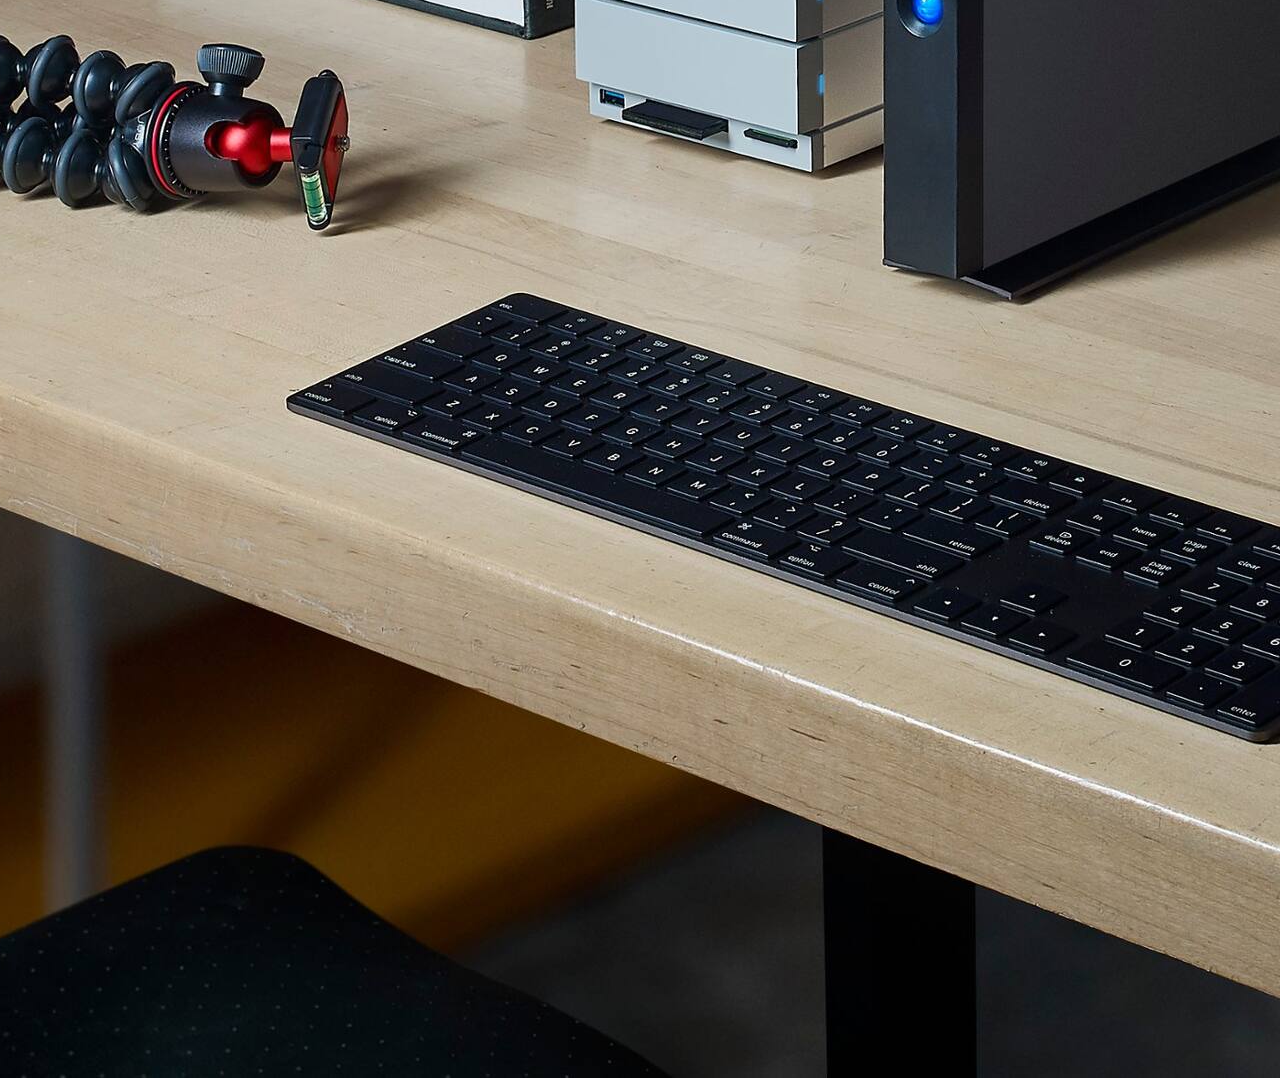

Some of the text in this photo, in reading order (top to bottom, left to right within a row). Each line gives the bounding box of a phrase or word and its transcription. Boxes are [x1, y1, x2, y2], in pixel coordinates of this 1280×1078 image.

[545, 345, 558, 353] 2
[384, 355, 401, 365] caps
[495, 354, 508, 362] Q
[533, 366, 549, 374] W
[573, 379, 587, 387] E
[505, 388, 518, 396] S
[613, 392, 626, 400] R
[304, 392, 332, 402] control
[446, 399, 460, 408] Z
[544, 400, 558, 408] D
[374, 415, 398, 426] option
[485, 413, 500, 421] X
[697, 418, 709, 426] Y
[526, 426, 539, 434] C
[626, 427, 639, 435] G
[421, 431, 459, 446] command
[568, 439, 581, 447] V
[666, 440, 682, 449] H
[607, 453, 621, 461] B
[648, 466, 664, 475] N
[751, 468, 766, 476] K
[689, 480, 707, 489] M
[1023, 498, 1050, 510] delete
[1092, 514, 1103, 522] fn
[1131, 526, 1157, 538] home
[721, 532, 763, 549] command
[1044, 534, 1071, 546] delete
[1183, 539, 1208, 550] page
[948, 539, 976, 552] return
[1181, 545, 1196, 553] up
[1099, 549, 1119, 558] end
[787, 555, 815, 567] option
[1237, 560, 1261, 571] clear
[916, 563, 938, 574] shift
[1140, 565, 1165, 577] down
[1148, 561, 1172, 572] page
[868, 582, 901, 595] control
[1208, 582, 1221, 590] 7
[1256, 599, 1269, 607] 8
[1219, 621, 1233, 630] 5
[1135, 628, 1145, 636] 1
[1181, 644, 1195, 653] 2
[1118, 658, 1132, 667] 0
[1232, 661, 1245, 670] 3
[1230, 705, 1257, 718] enter
